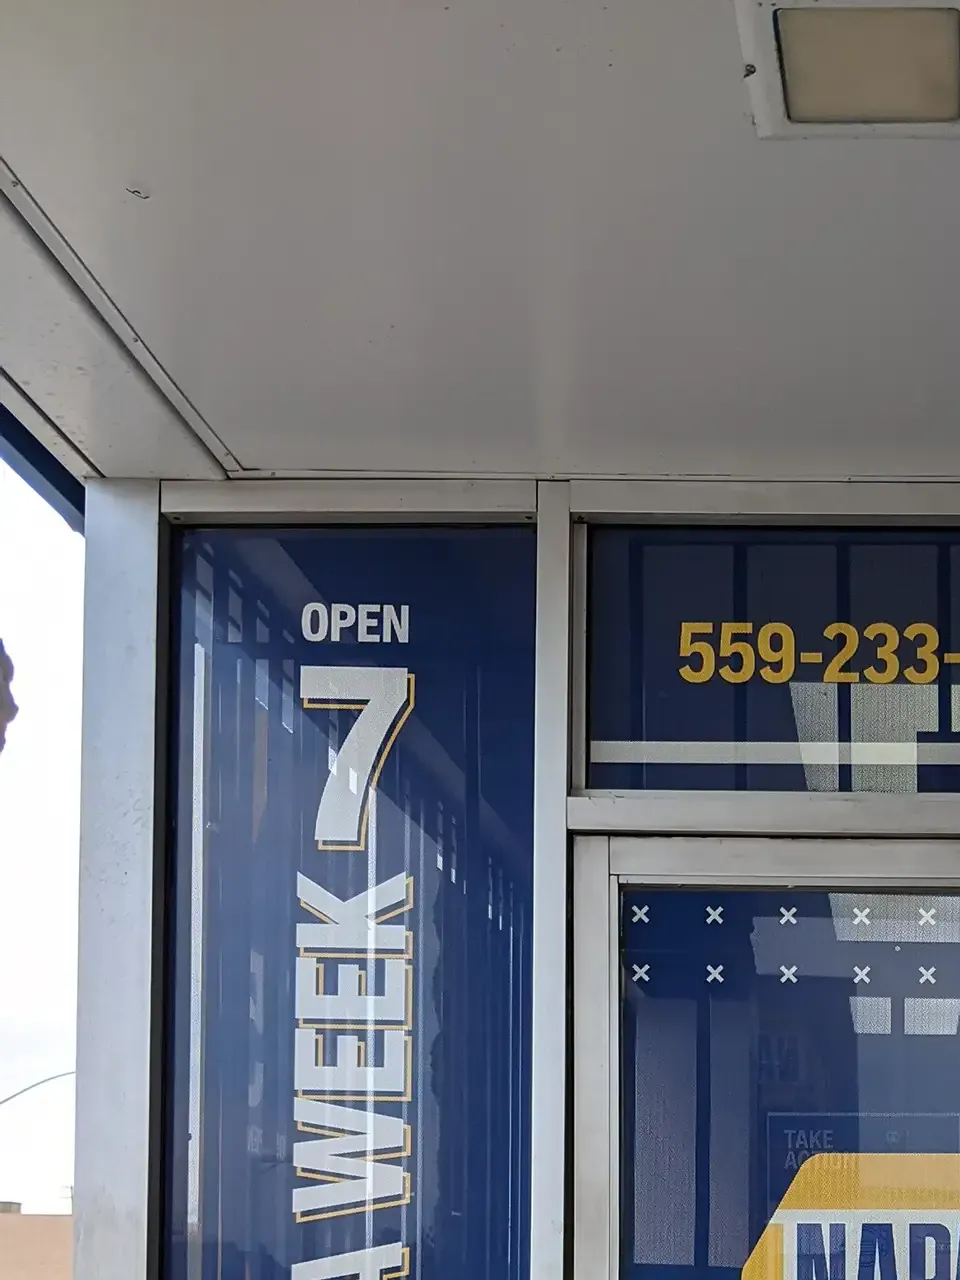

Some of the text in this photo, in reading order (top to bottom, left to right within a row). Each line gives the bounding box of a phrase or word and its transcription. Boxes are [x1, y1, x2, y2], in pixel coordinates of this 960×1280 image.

[301, 602, 409, 644] OPEN
[300, 665, 415, 851] 7
[292, 871, 415, 1223] WEEK
[783, 1129, 834, 1149] TAKE
